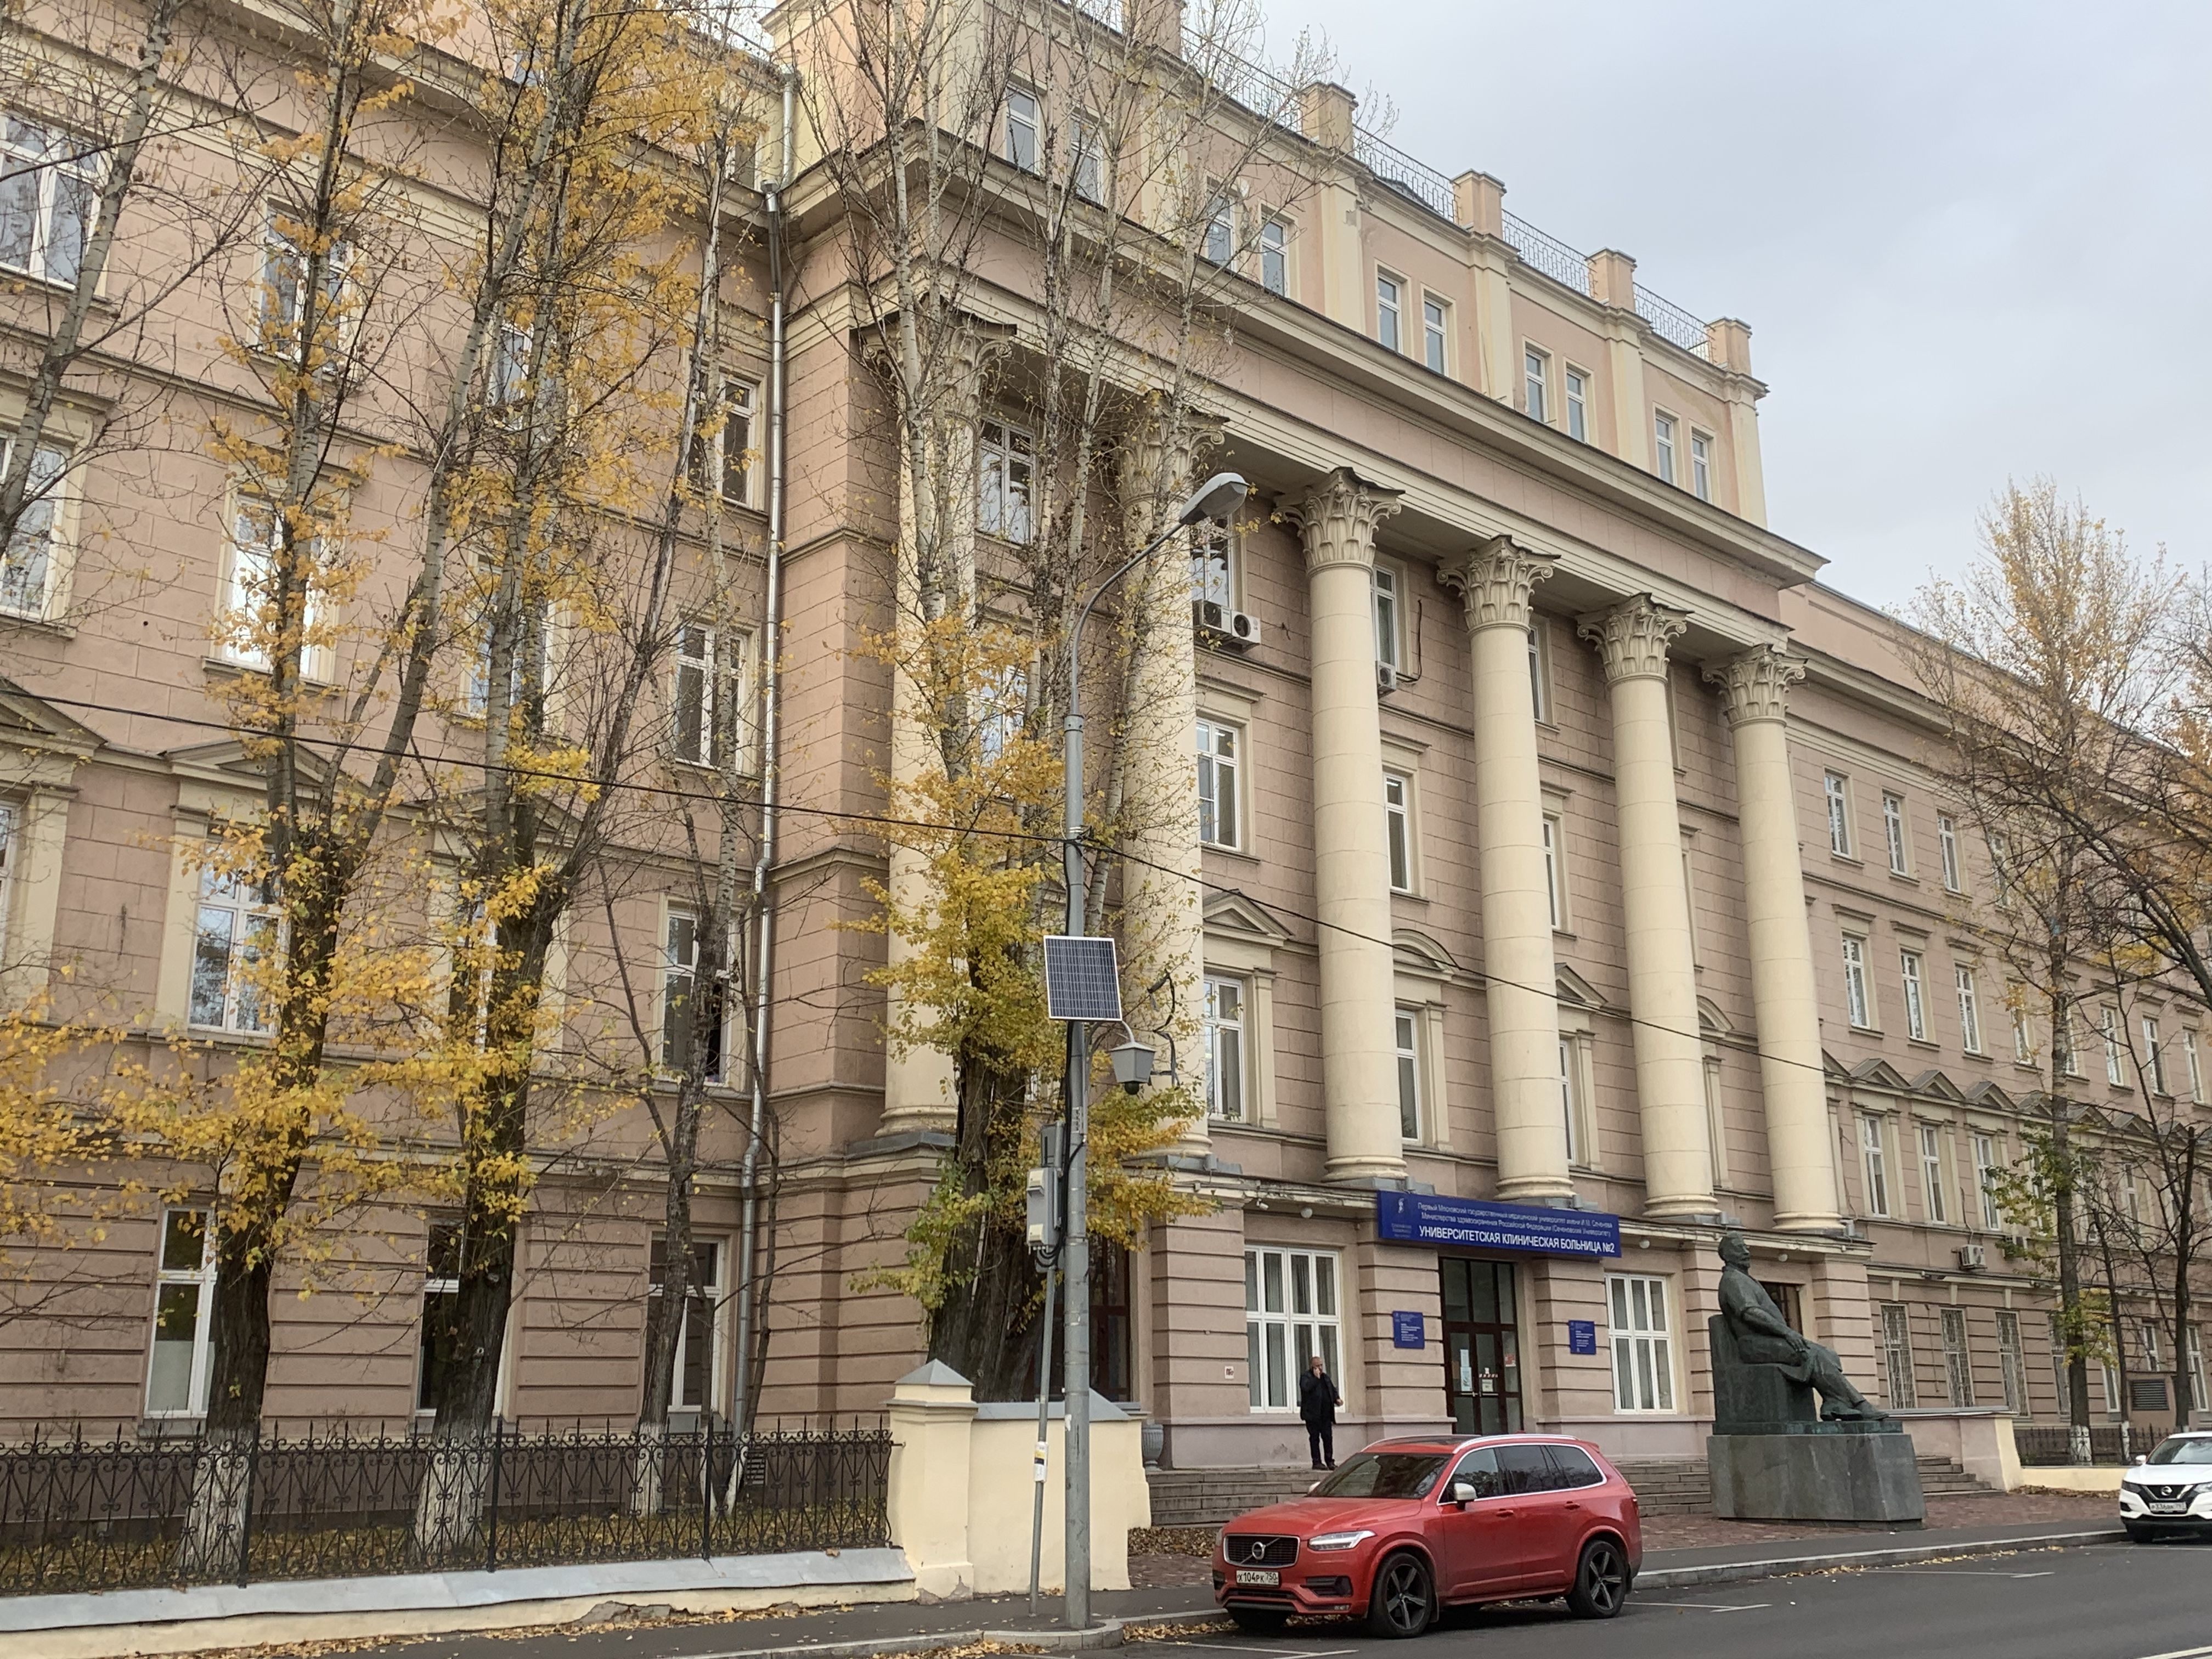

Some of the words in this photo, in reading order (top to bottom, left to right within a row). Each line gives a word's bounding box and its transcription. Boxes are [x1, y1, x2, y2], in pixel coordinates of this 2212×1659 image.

[1438, 1204, 1466, 1214] Московский
[1419, 1224, 1501, 1244] УНИВЕРСИТЕТСКАЯ
[1502, 1233, 1560, 1249] КЛИНИЧЕСКАЯ
[1560, 1238, 1602, 1254] БОЛЬНИЦА
[1602, 1242, 1615, 1254] №2
